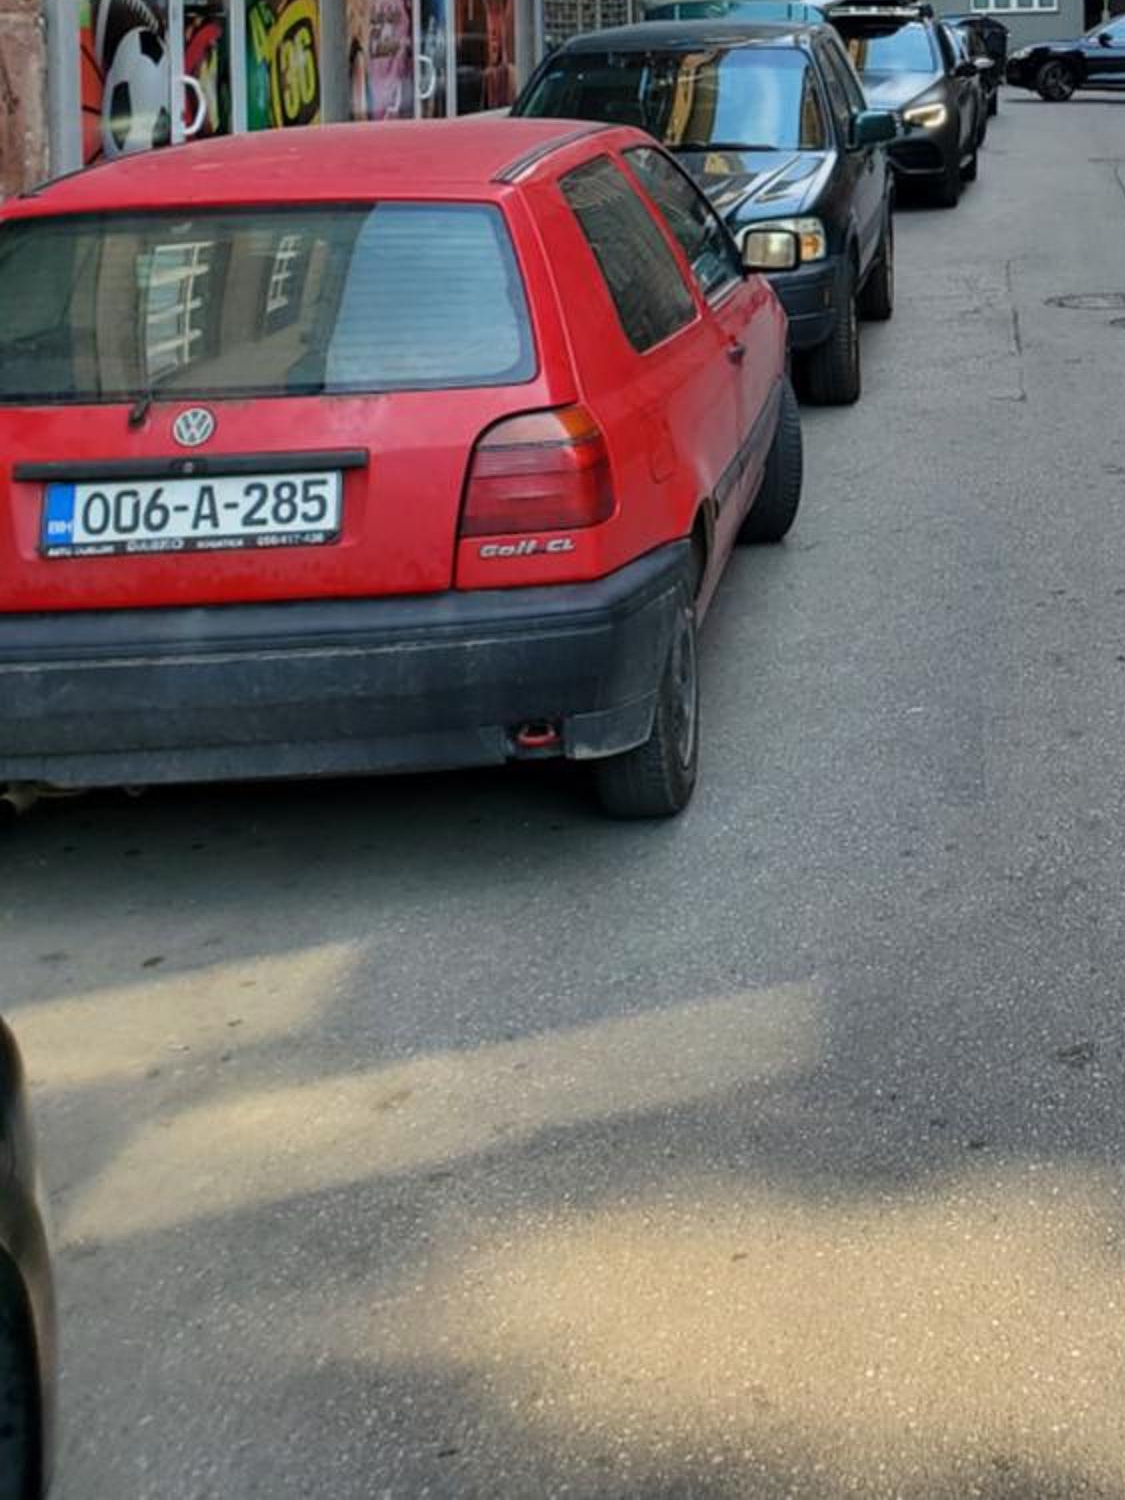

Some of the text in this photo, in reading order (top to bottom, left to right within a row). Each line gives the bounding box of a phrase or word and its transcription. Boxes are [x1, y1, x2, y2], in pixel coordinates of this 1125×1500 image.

[82, 478, 329, 535] 006-A-285
[479, 538, 577, 558] Golf CL
